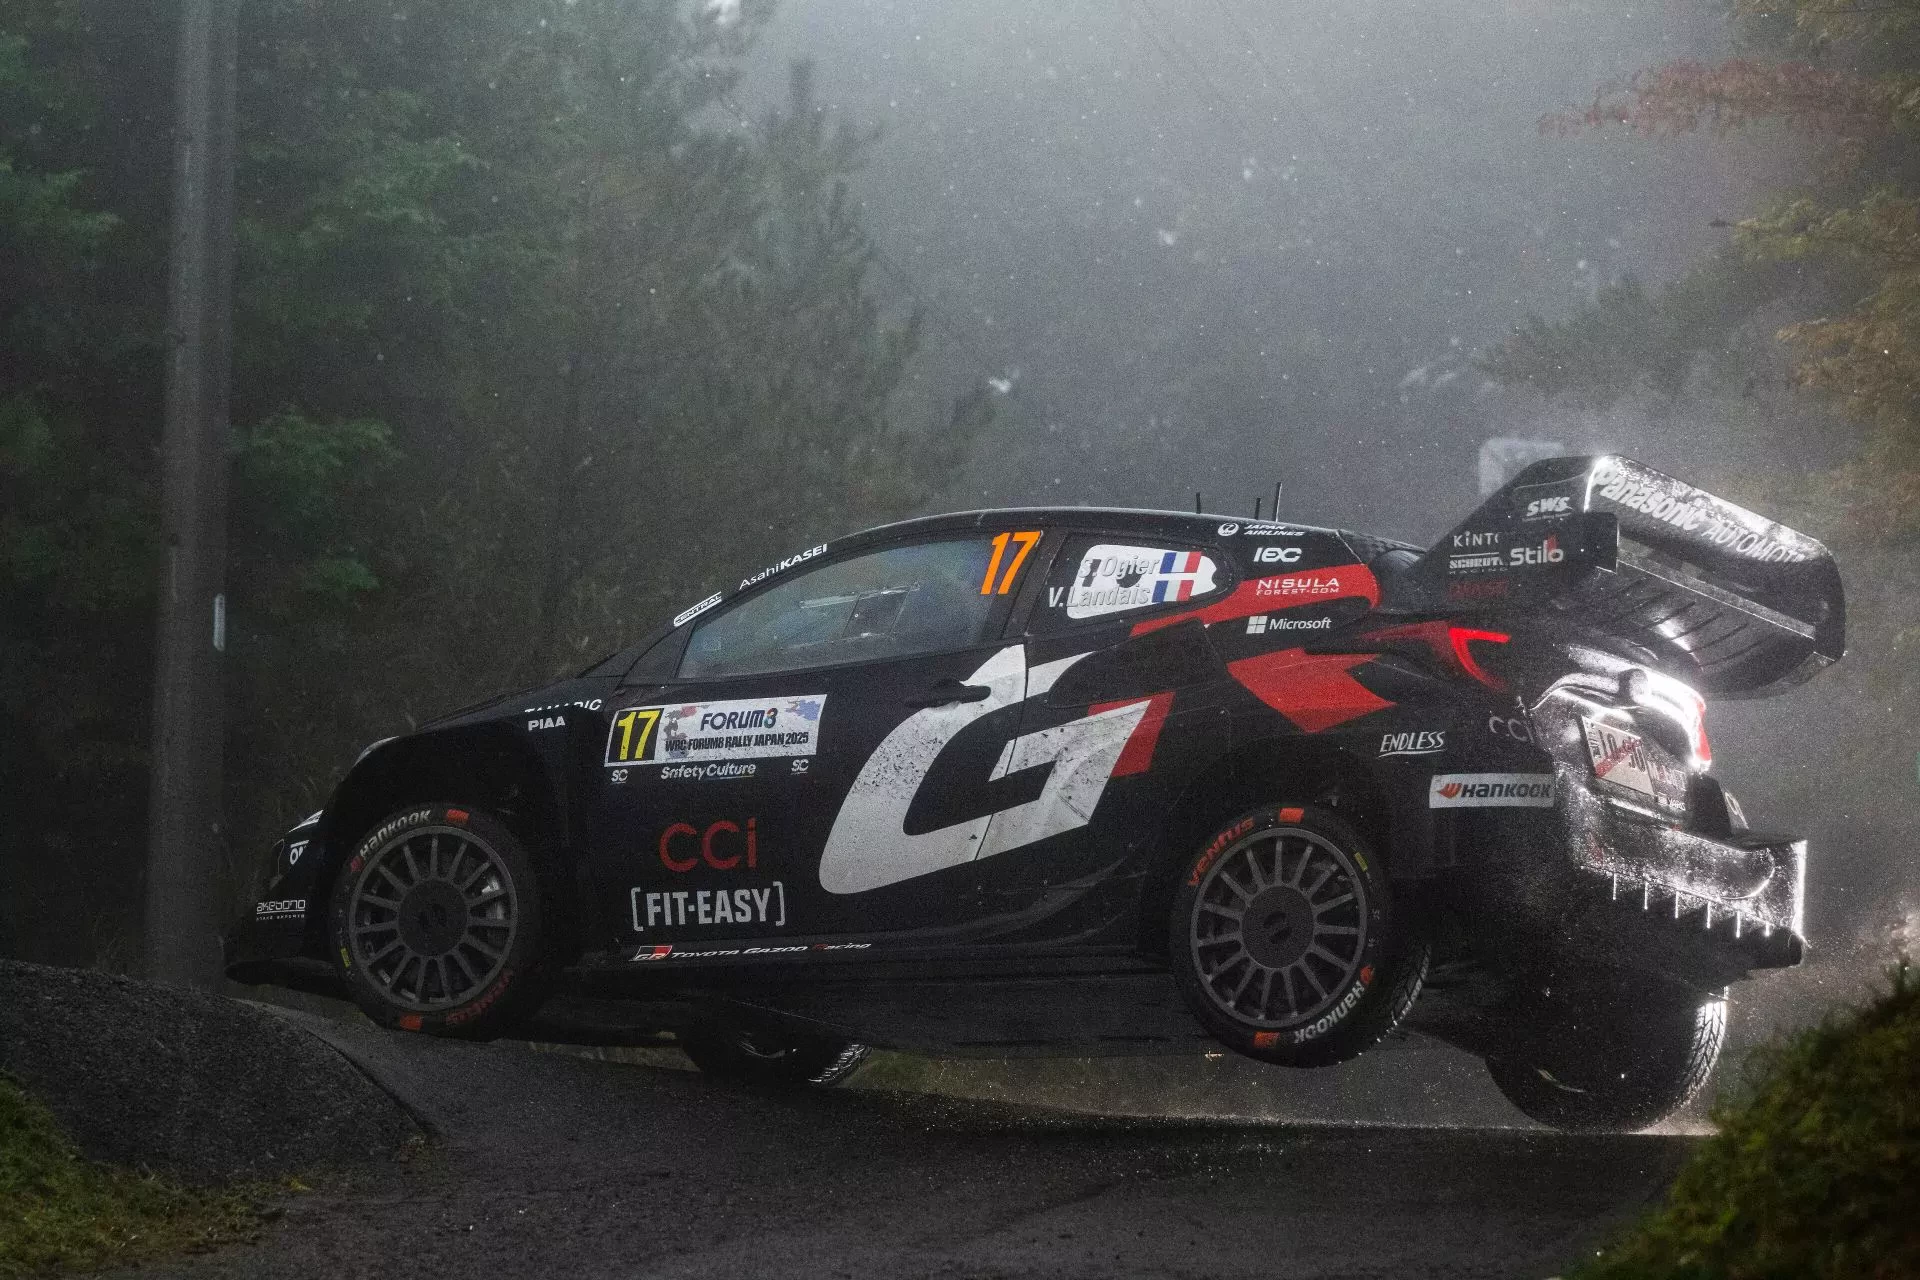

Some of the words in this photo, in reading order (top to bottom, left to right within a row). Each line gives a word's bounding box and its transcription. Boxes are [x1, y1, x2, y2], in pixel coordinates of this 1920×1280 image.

[1526, 497, 1570, 516] SWS
[1510, 540, 1564, 566] Stilo
[980, 531, 1041, 595] 17
[1257, 578, 1340, 590] NISULA
[1269, 616, 1332, 630] Microsoft
[528, 716, 565, 731] PIAA
[700, 708, 778, 731] FORUM8
[617, 709, 661, 761] 17
[665, 738, 687, 751] WRC
[688, 736, 725, 750] FORUM8
[725, 735, 751, 748] RALLY
[754, 732, 785, 747] JAPAN
[785, 731, 809, 745] 2025
[1380, 731, 1445, 753] ENDLESS
[660, 762, 757, 780] SafetyCulture
[791, 758, 809, 772] SC
[610, 769, 629, 782] SC
[671, 949, 740, 958] TOYOTA
